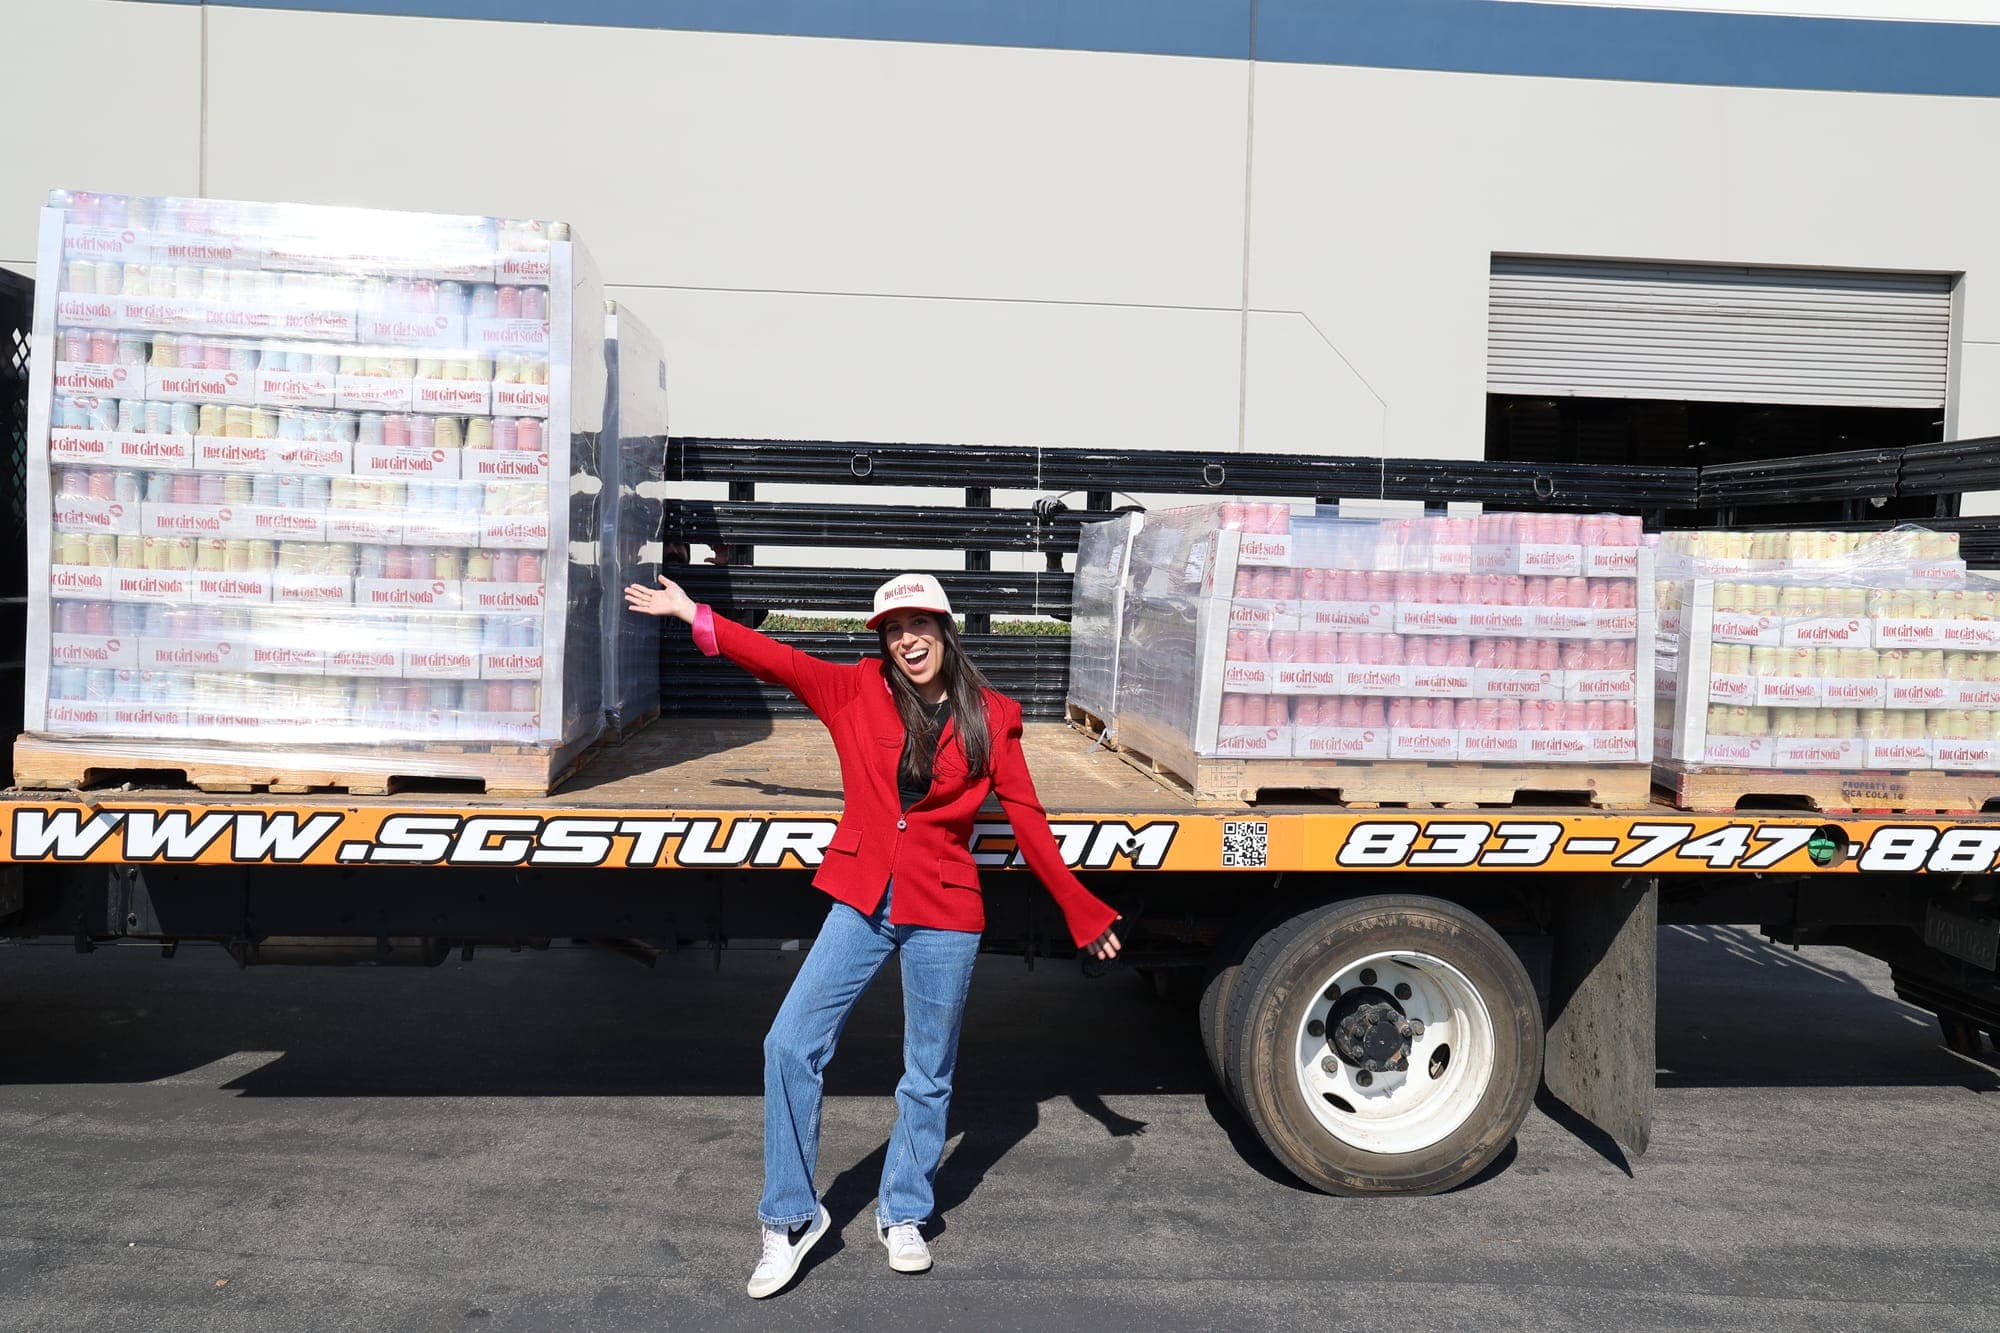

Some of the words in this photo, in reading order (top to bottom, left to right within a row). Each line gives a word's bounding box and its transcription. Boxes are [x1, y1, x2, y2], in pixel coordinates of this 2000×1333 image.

[504, 263, 520, 274] Hot
[68, 374, 88, 388] Girl
[88, 377, 114, 389] Soda
[162, 380, 180, 392] Hot
[181, 380, 200, 394] Girl
[200, 381, 225, 395] Soda
[499, 392, 515, 404] Hot
[516, 392, 533, 405] Girl
[58, 439, 78, 452] Girl
[79, 441, 104, 453] Soda
[121, 442, 139, 455] Hot
[140, 442, 159, 456] Girl
[160, 444, 184, 457] Soda
[221, 447, 240, 459] Girl
[241, 448, 266, 460] Soda
[371, 458, 388, 469] Hot
[389, 457, 407, 470] Girl
[408, 459, 432, 471] Soda
[479, 462, 496, 473] Hot
[497, 462, 514, 475] Girl
[515, 463, 539, 475] Soda
[64, 510, 84, 524] Girl
[85, 513, 110, 526] Soda
[157, 516, 175, 528] Hot
[176, 516, 194, 529] Girl
[194, 518, 219, 530] Soda
[1594, 556, 1608, 566] Hot
[1609, 555, 1623, 567] Girl
[120, 580, 137, 591] Hot
[138, 579, 158, 592] Girl
[158, 581, 182, 593] Soda
[200, 581, 217, 593] Hot
[218, 580, 236, 593] Girl
[237, 583, 262, 594] Soda
[372, 591, 390, 602] Hot
[391, 589, 408, 602] Girl
[409, 591, 433, 603] Soda
[479, 594, 495, 606] Hot
[496, 594, 515, 606] Girl
[516, 595, 538, 606] Soda
[1236, 608, 1252, 622] Girl
[1470, 614, 1486, 625] Hot
[1487, 615, 1501, 625] Girl
[1502, 616, 1522, 628] Soda
[1722, 623, 1738, 636] Girl
[1739, 626, 1758, 637] Soda
[1813, 627, 1828, 640] Girl
[1829, 629, 1848, 640] Soda
[1883, 626, 1897, 637] Hot
[1898, 626, 1912, 637] Girl
[1913, 627, 1933, 638] Soda
[1945, 629, 1959, 639] Hot
[1960, 628, 1975, 641] Girl
[63, 646, 82, 659] Girl
[82, 648, 108, 660] Soda
[156, 650, 173, 662] Hot
[174, 649, 193, 662] Girl
[194, 652, 219, 663] Soda
[254, 650, 273, 662] Hot
[274, 650, 291, 662] Girl
[370, 654, 394, 666] Soda
[411, 656, 427, 666] Hot
[428, 654, 445, 667] Girl
[446, 656, 470, 667] Soda
[488, 656, 506, 668] Hot
[507, 655, 523, 668] Girl
[1227, 668, 1243, 680] Girl
[1244, 671, 1264, 682] Soda
[1280, 672, 1295, 683] Hot
[1296, 671, 1312, 683] Girl
[1313, 672, 1333, 684] Soda
[1363, 671, 1379, 684] Girl
[1380, 673, 1400, 686] Soda
[1580, 682, 1594, 692] Hot
[1595, 680, 1609, 693] Girl
[1610, 682, 1630, 692] Soda
[1713, 680, 1728, 692] Girl
[1729, 683, 1747, 694] Soda
[1765, 684, 1780, 696] Hot
[1781, 685, 1794, 697] Girl
[1795, 686, 1814, 697] Soda
[1829, 687, 1842, 697] Hot
[1843, 687, 1858, 698] Girl
[1859, 687, 1878, 697] Soda
[1894, 688, 1907, 699] Hot
[1908, 687, 1923, 699] Girl
[1924, 688, 1943, 699] Soda
[1960, 692, 1974, 703] Hot
[1975, 692, 1990, 703] Girl
[1310, 739, 1326, 751] Hot
[1327, 739, 1341, 751] Girl
[1342, 740, 1363, 751] Soda
[1398, 736, 1413, 747] Hot
[1414, 735, 1429, 747] Girl
[1430, 737, 1450, 748] Soda
[1466, 737, 1480, 749] Hot
[1481, 737, 1496, 749] Girl
[1532, 740, 1546, 751] Hot
[1547, 739, 1562, 751] Girl
[1714, 746, 1730, 758] Girl
[1731, 748, 1750, 759] Soda
[1790, 750, 1804, 759] Hot
[1804, 750, 1819, 760] Girl
[1820, 750, 1840, 760] Soda
[1875, 748, 1889, 758] Hot
[1890, 746, 1904, 758] Girl
[1940, 749, 1953, 760] Hot
[1954, 749, 1968, 761] Girl
[1970, 751, 1989, 761] Soda
[1865, 790, 1888, 800] COLA
